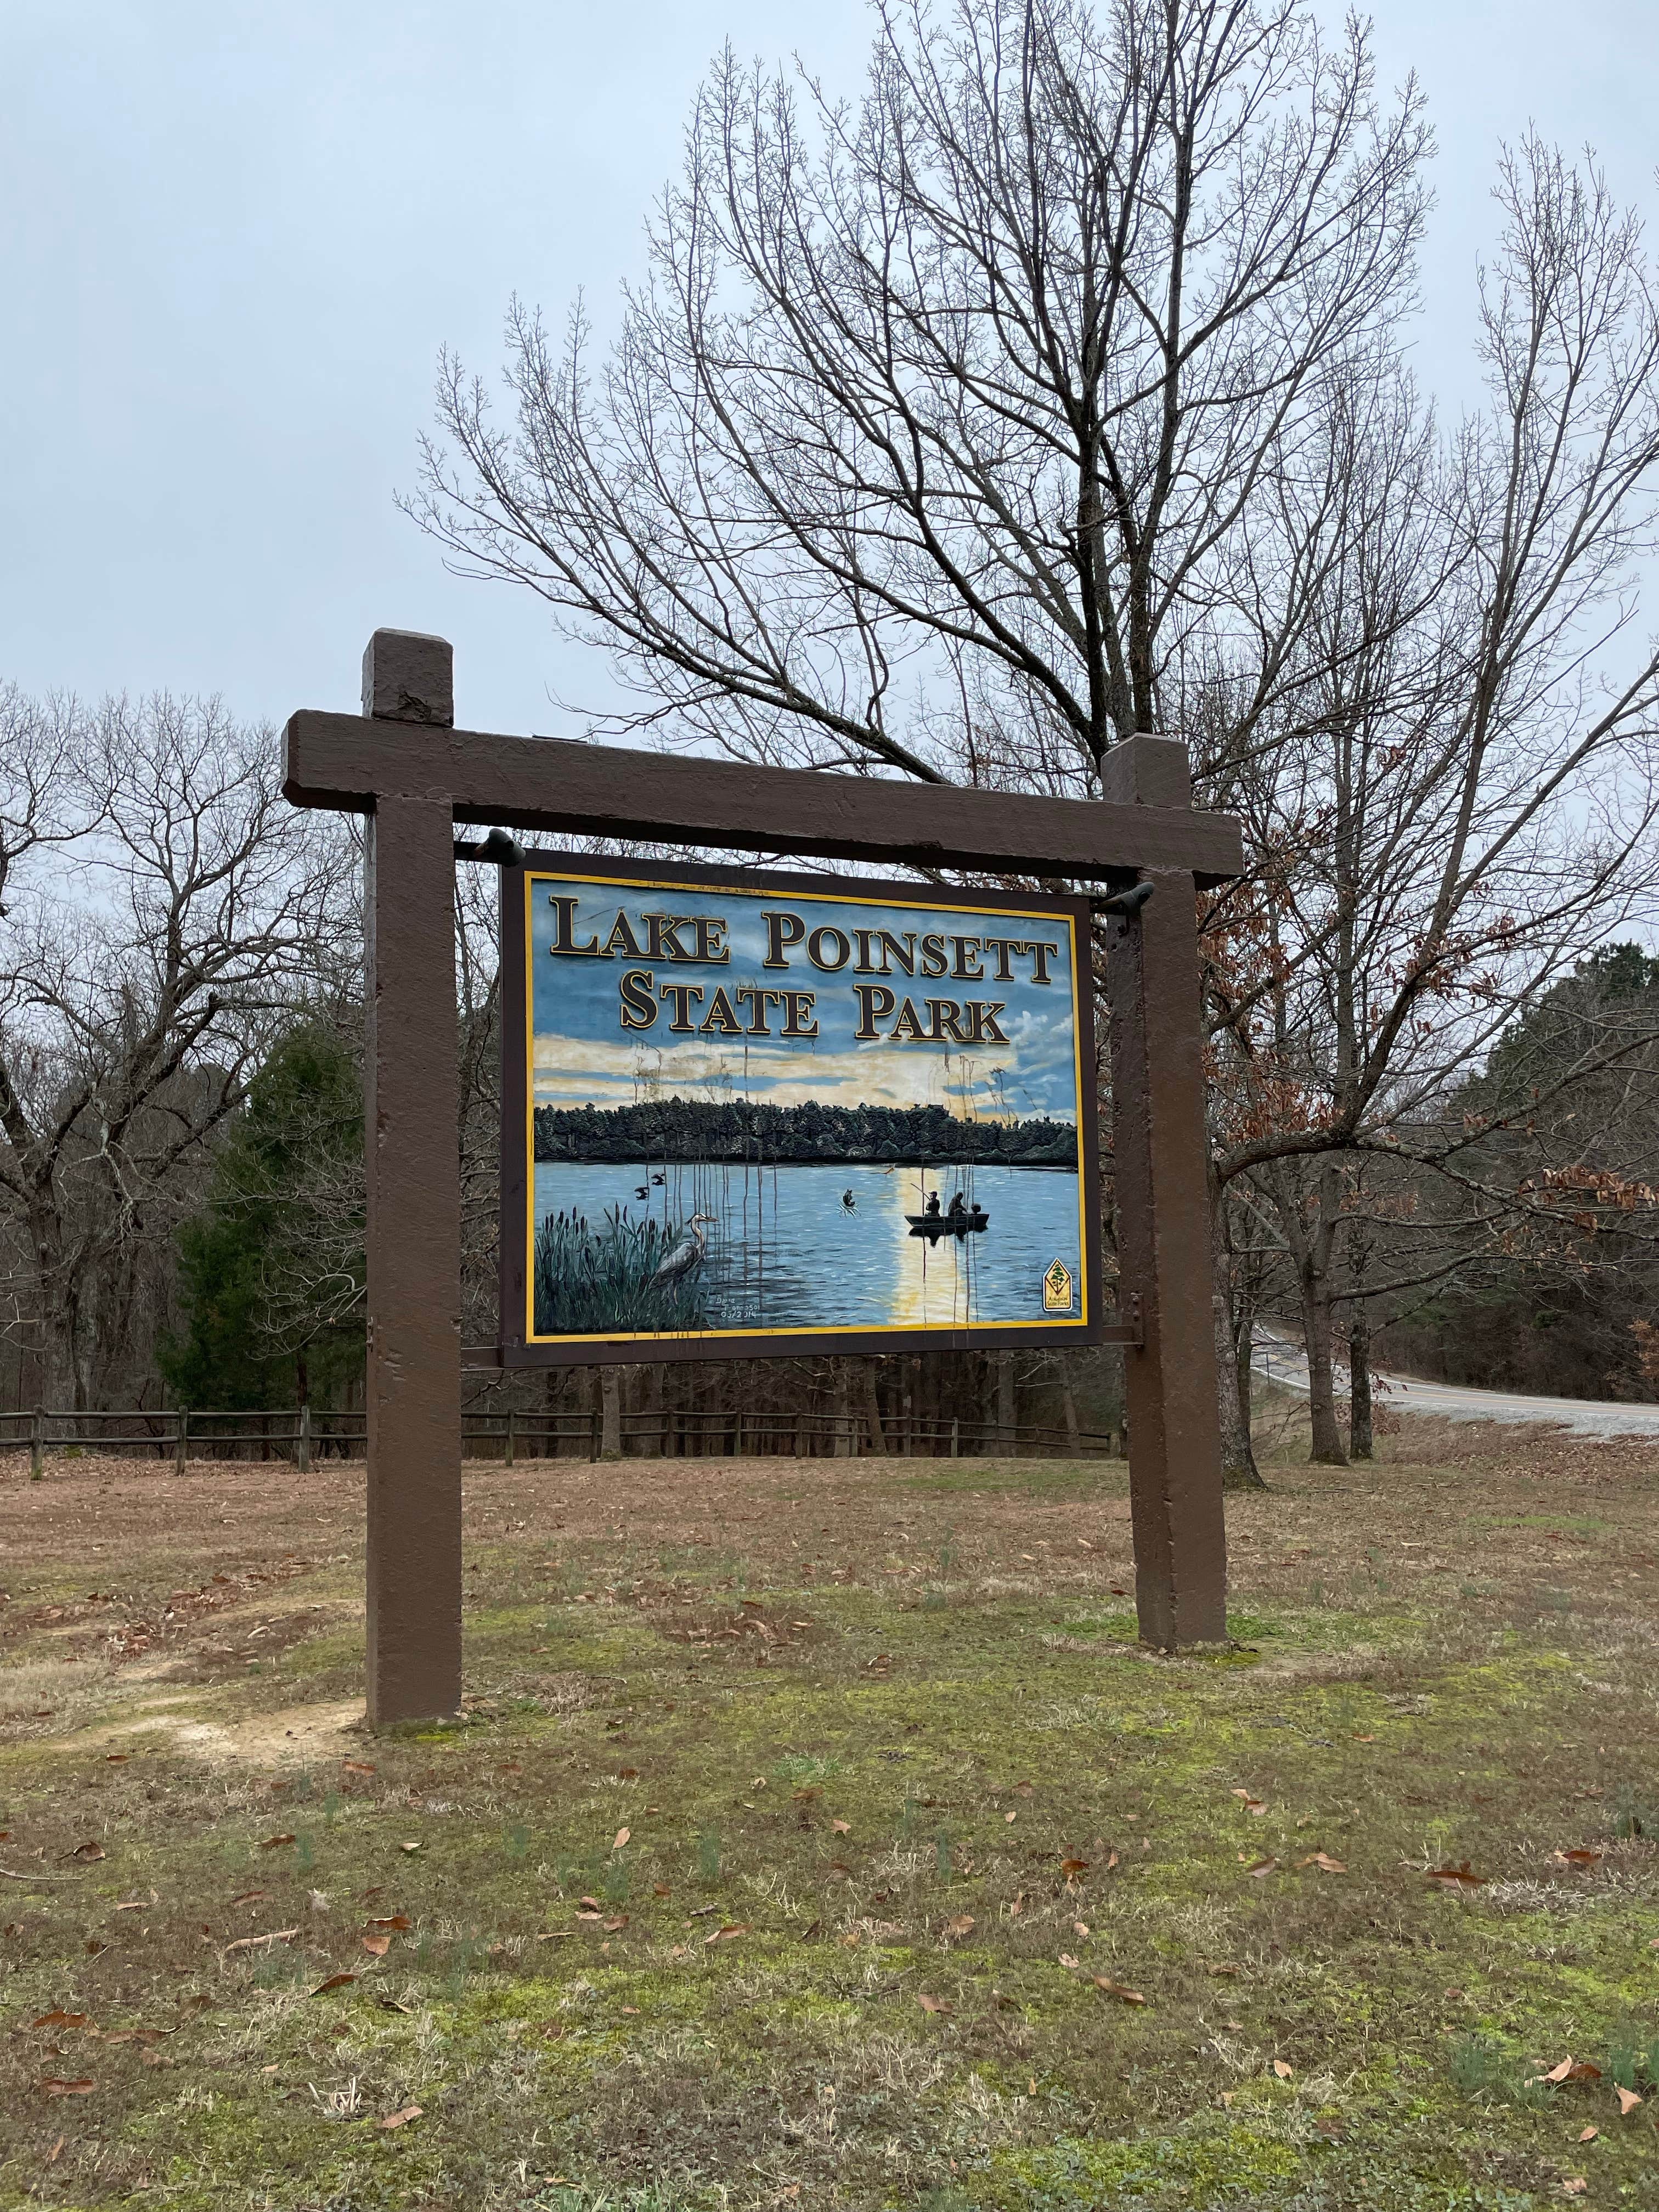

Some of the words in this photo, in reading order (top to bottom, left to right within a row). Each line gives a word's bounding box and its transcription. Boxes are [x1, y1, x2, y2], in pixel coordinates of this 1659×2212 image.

[549, 895, 730, 963] LAKE
[760, 911, 1058, 983] POINSETT
[620, 969, 819, 1036] STATE
[853, 983, 1011, 1044] PARK
